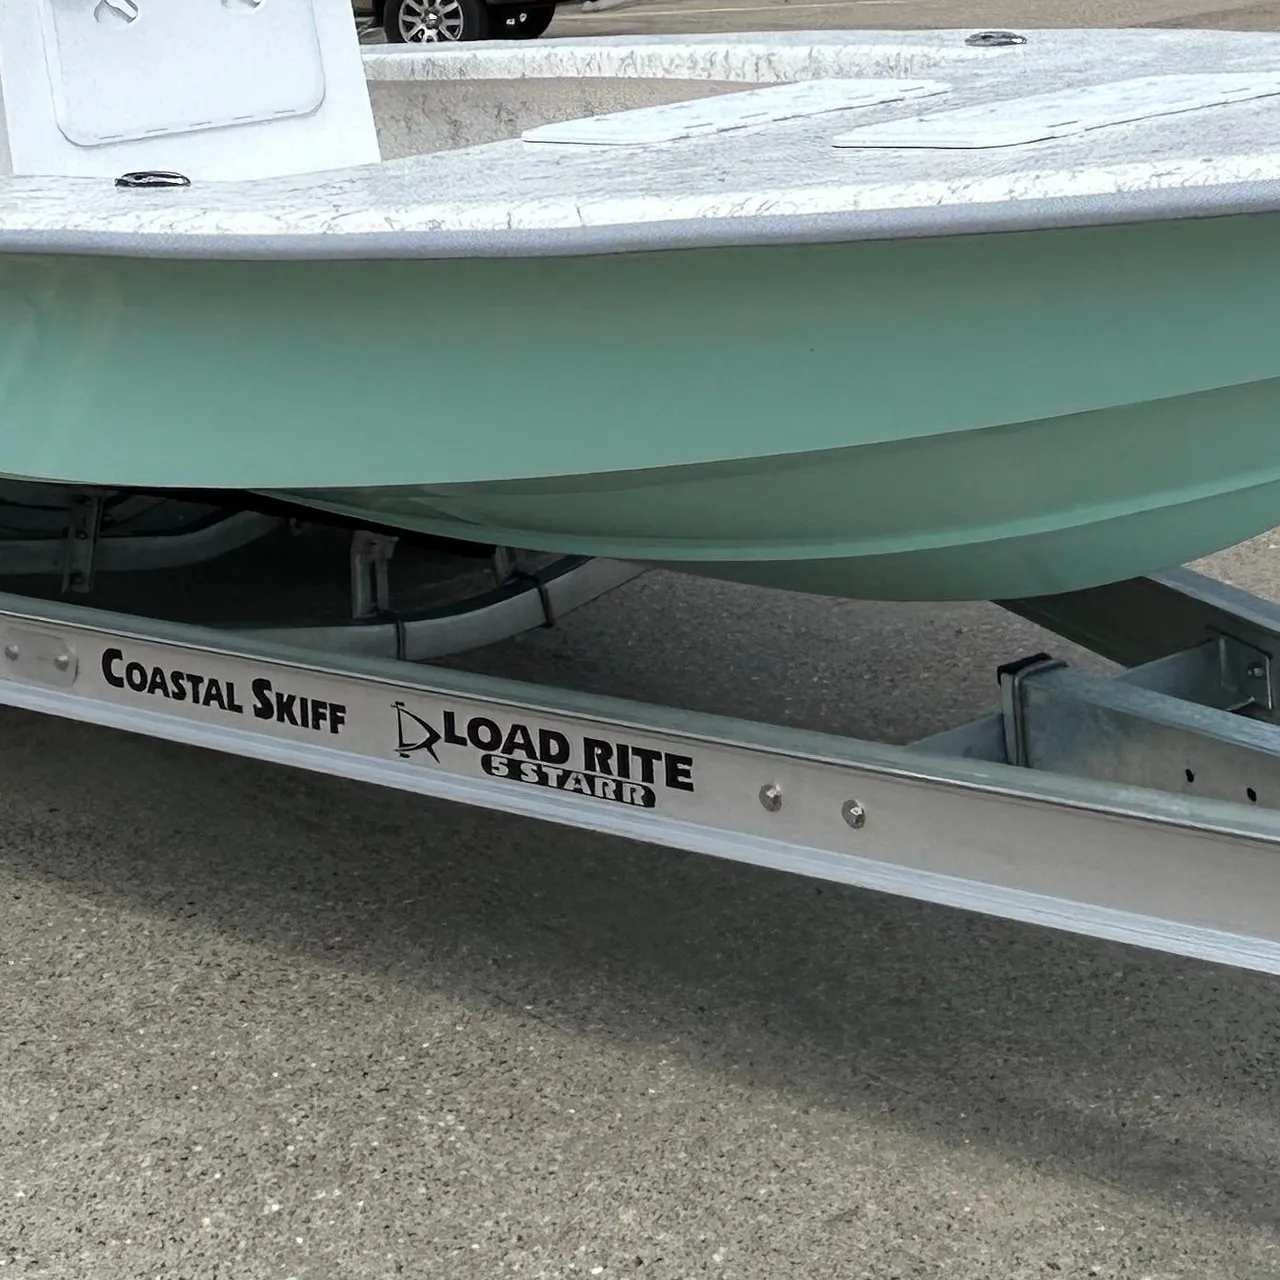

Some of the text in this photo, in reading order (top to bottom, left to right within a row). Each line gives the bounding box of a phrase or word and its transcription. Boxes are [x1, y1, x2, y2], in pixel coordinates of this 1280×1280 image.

[101, 647, 347, 734] COASTAL SKIFF
[442, 709, 695, 792] LOAD RITE
[490, 755, 647, 807] 5 STARR
